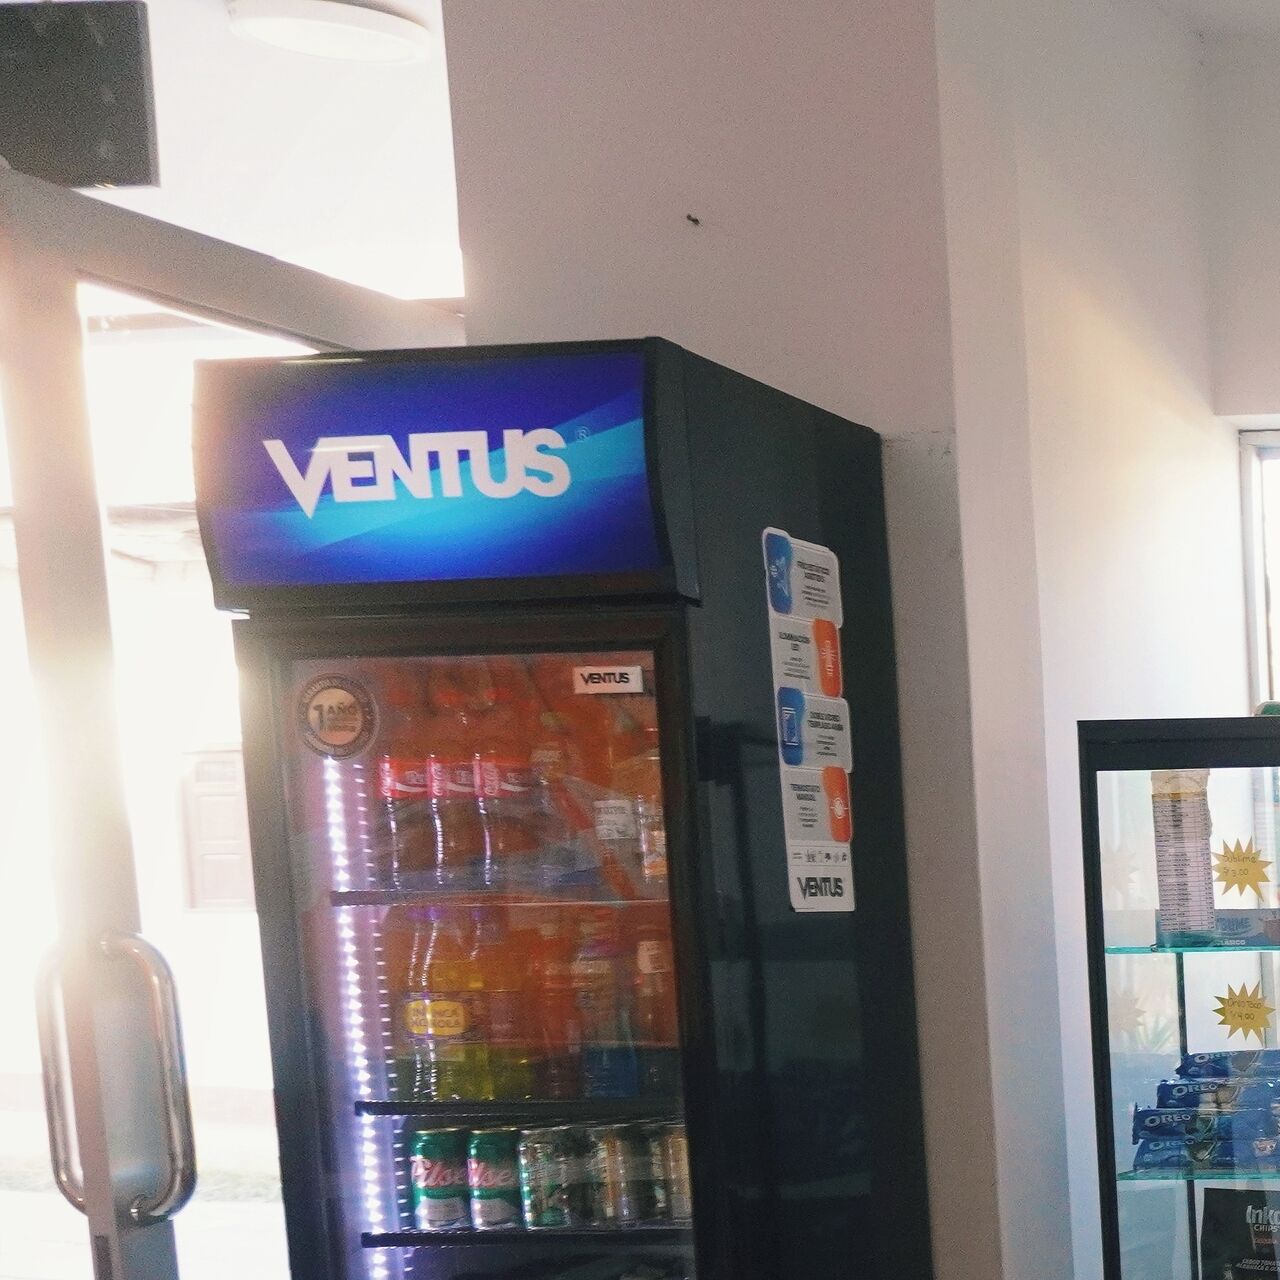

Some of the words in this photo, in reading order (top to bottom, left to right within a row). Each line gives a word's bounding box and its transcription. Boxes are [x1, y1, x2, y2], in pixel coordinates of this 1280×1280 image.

[263, 428, 571, 519] VENTUS
[580, 672, 630, 684] VENTUS
[1222, 854, 1257, 864] Sublime
[797, 877, 844, 900] VENTUS
[1172, 1083, 1218, 1096] OREO
[1144, 1113, 1191, 1127] OREO
[1254, 1224, 1279, 1232] CHIPS
